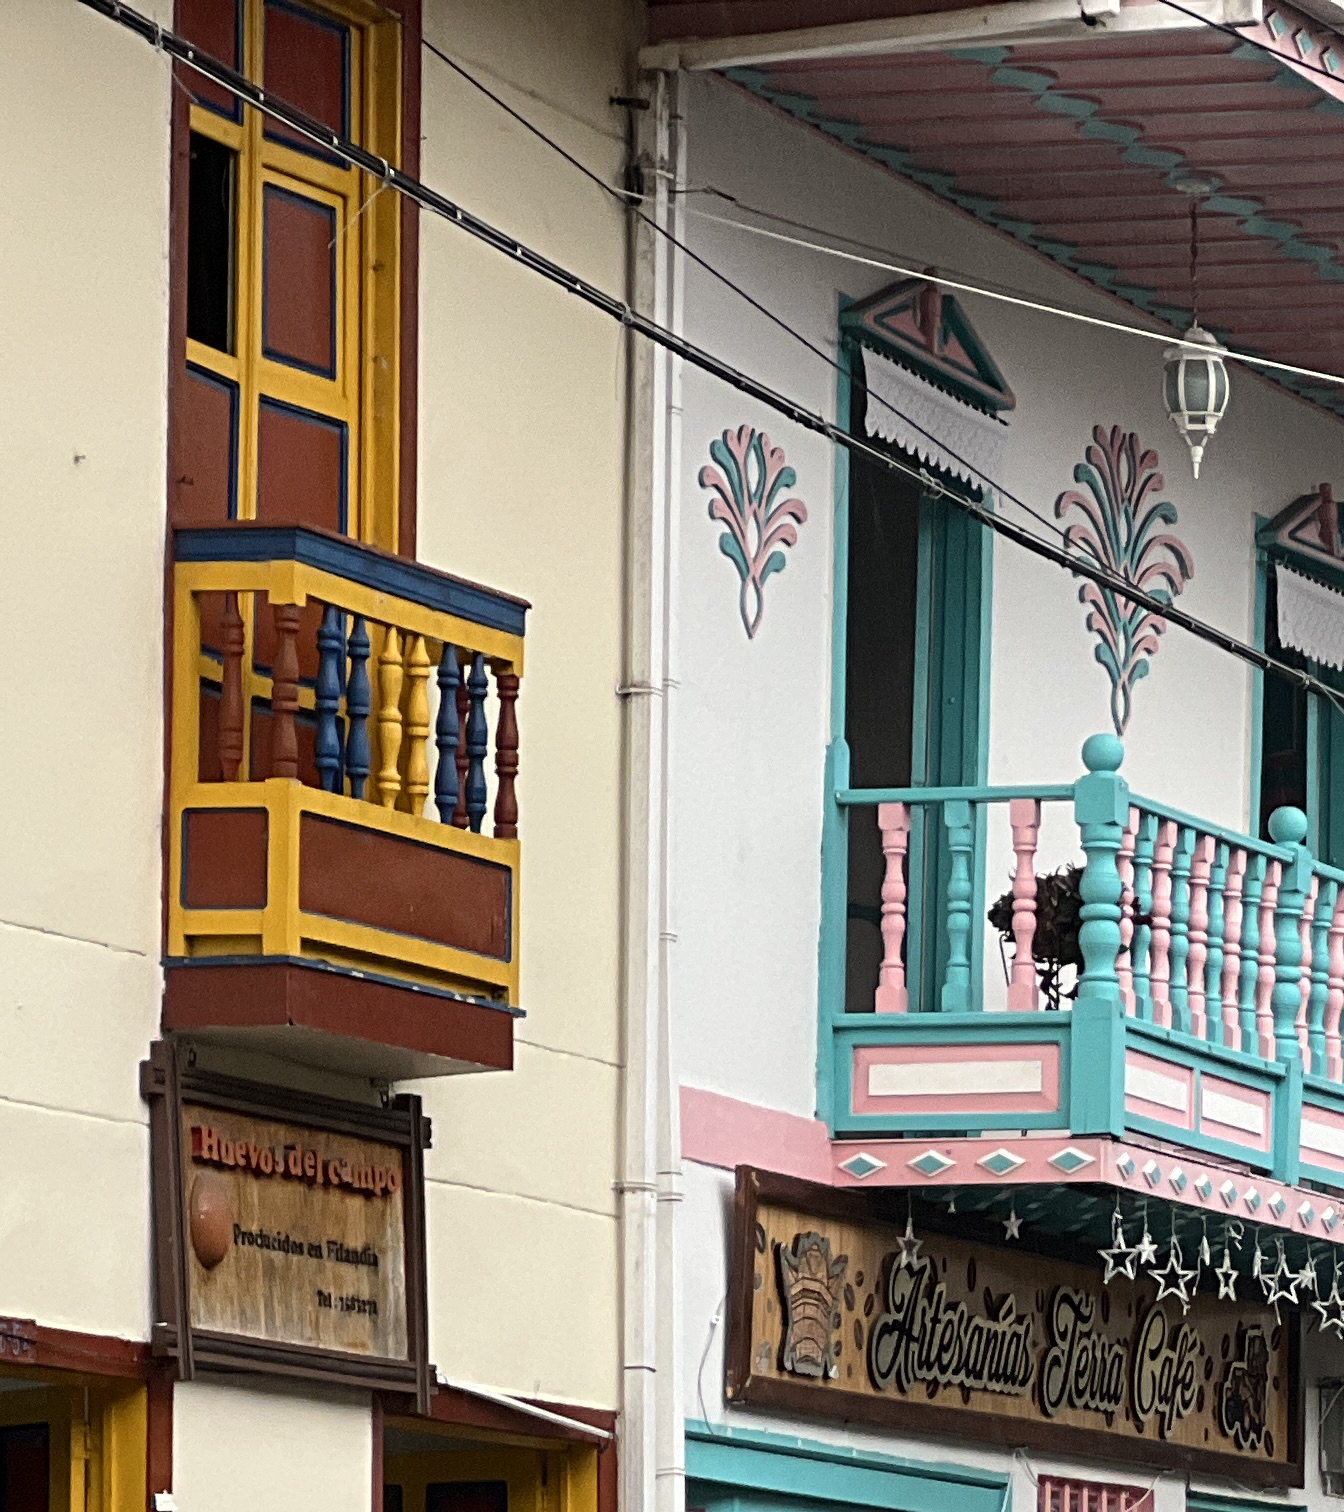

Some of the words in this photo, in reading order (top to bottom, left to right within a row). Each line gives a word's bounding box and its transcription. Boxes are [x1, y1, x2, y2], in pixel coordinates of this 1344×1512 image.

[202, 1126, 285, 1174] Huevos
[288, 1146, 323, 1185] del
[328, 1160, 400, 1194] campo
[233, 1223, 304, 1257] Producidos
[307, 1241, 323, 1259] en
[326, 1240, 379, 1268] Filandia
[870, 1253, 1034, 1394] Artesanías
[1043, 1286, 1126, 1416] Terra
[1136, 1302, 1199, 1437] Café
